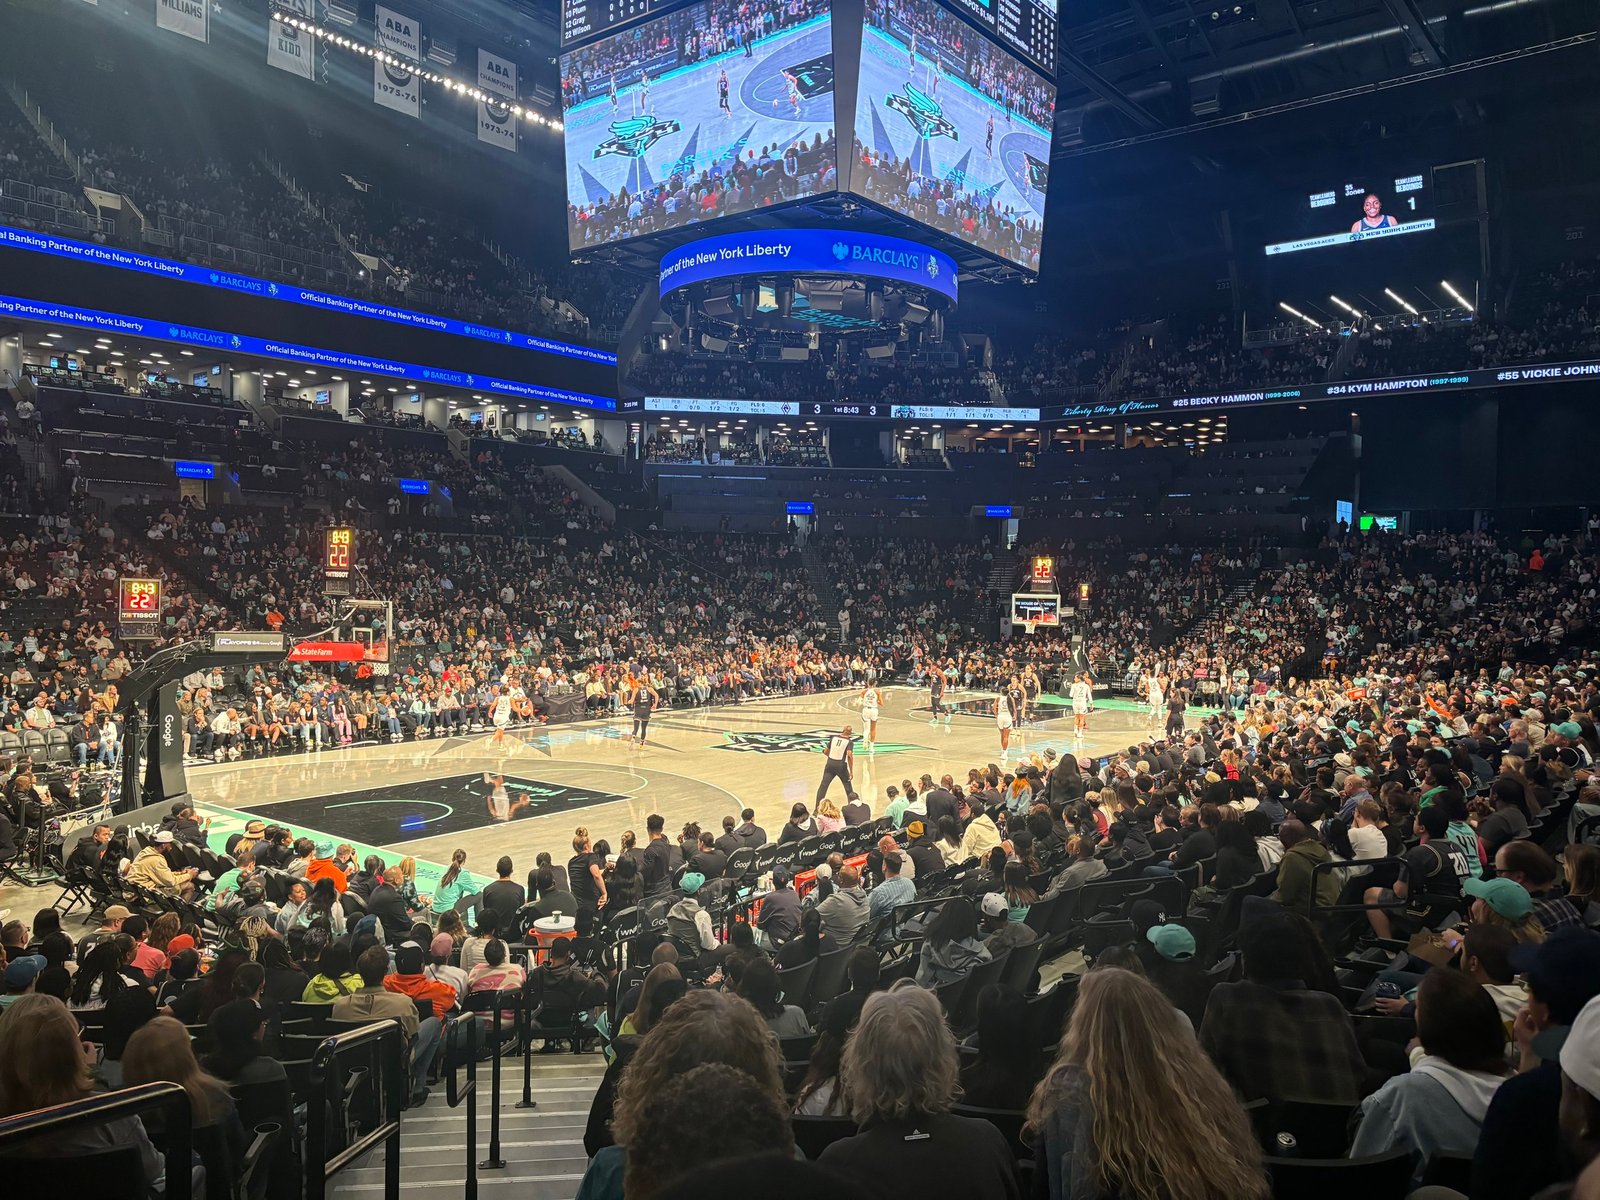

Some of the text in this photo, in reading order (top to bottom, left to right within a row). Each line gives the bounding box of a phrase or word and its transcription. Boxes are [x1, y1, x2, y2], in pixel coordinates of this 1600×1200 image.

[162, 0, 202, 18] WILLIAMS
[572, 6, 586, 16] Plum
[385, 18, 411, 37] ABA
[572, 16, 585, 26] Gray
[565, 31, 572, 39] 22
[572, 24, 591, 36] Wilson
[278, 38, 301, 58] KIDD
[378, 31, 417, 52] CHAMPIONS
[487, 61, 509, 78] ABA
[480, 73, 514, 92] CHAMPIONS
[378, 82, 417, 103] 1975-76
[480, 120, 514, 139] 1973-74
[1345, 188, 1365, 196] Jones
[1408, 197, 1415, 210] 1
[1566, 231, 1584, 241] 201
[8, 232, 47, 249] Banking
[48, 240, 83, 254] Partner
[84, 249, 95, 257] of
[95, 250, 111, 260] the
[112, 253, 132, 264] New
[133, 257, 153, 268] York
[154, 262, 184, 276] Liberty
[674, 260, 682, 271] of
[682, 257, 695, 269] the
[696, 252, 717, 266] New
[719, 247, 743, 260] York
[746, 243, 792, 258] Liberty
[852, 245, 919, 270] BARCLAYS
[220, 276, 262, 291] BARCLAYS
[15, 304, 47, 315] Partner
[59, 311, 74, 319] the
[75, 313, 94, 322] New
[95, 316, 114, 325] York
[115, 319, 143, 332] Liberty
[300, 292, 326, 303] Official
[327, 297, 353, 310] Banking
[354, 303, 377, 314] Partner
[386, 310, 396, 318] the
[398, 312, 411, 320] New
[411, 315, 426, 323] York
[426, 318, 447, 329] Liberty
[180, 330, 224, 344] BARCLAYS
[471, 327, 500, 339] BARCLAYS
[528, 339, 545, 348] Official
[546, 342, 565, 353] Banking
[565, 345, 583, 356] Partner
[266, 344, 290, 355] Official
[290, 349, 315, 360] Banking
[316, 352, 339, 363] Partner
[385, 364, 405, 374] Liberty
[431, 372, 461, 382] BARCLAYS
[1497, 372, 1519, 381] #55
[1522, 367, 1561, 379] VICKIE
[491, 382, 508, 390] Official
[509, 384, 527, 394] Banking
[528, 388, 544, 396] Partner
[578, 395, 593, 405] Liberty
[1327, 376, 1469, 395] #34 KYM HAMPTON (1997-1999)
[1173, 390, 1300, 407] #25 BECKY HAMMON (1999-2006)
[814, 404, 821, 414] 3
[870, 406, 876, 415] 3
[1062, 401, 1159, 417] Liberty Ring Of Honor
[333, 531, 349, 543] 8:43
[330, 545, 347, 566] 22
[1035, 566, 1050, 577] 22
[132, 583, 154, 594] 8:43
[130, 594, 150, 608] 22
[163, 715, 174, 747] Google
